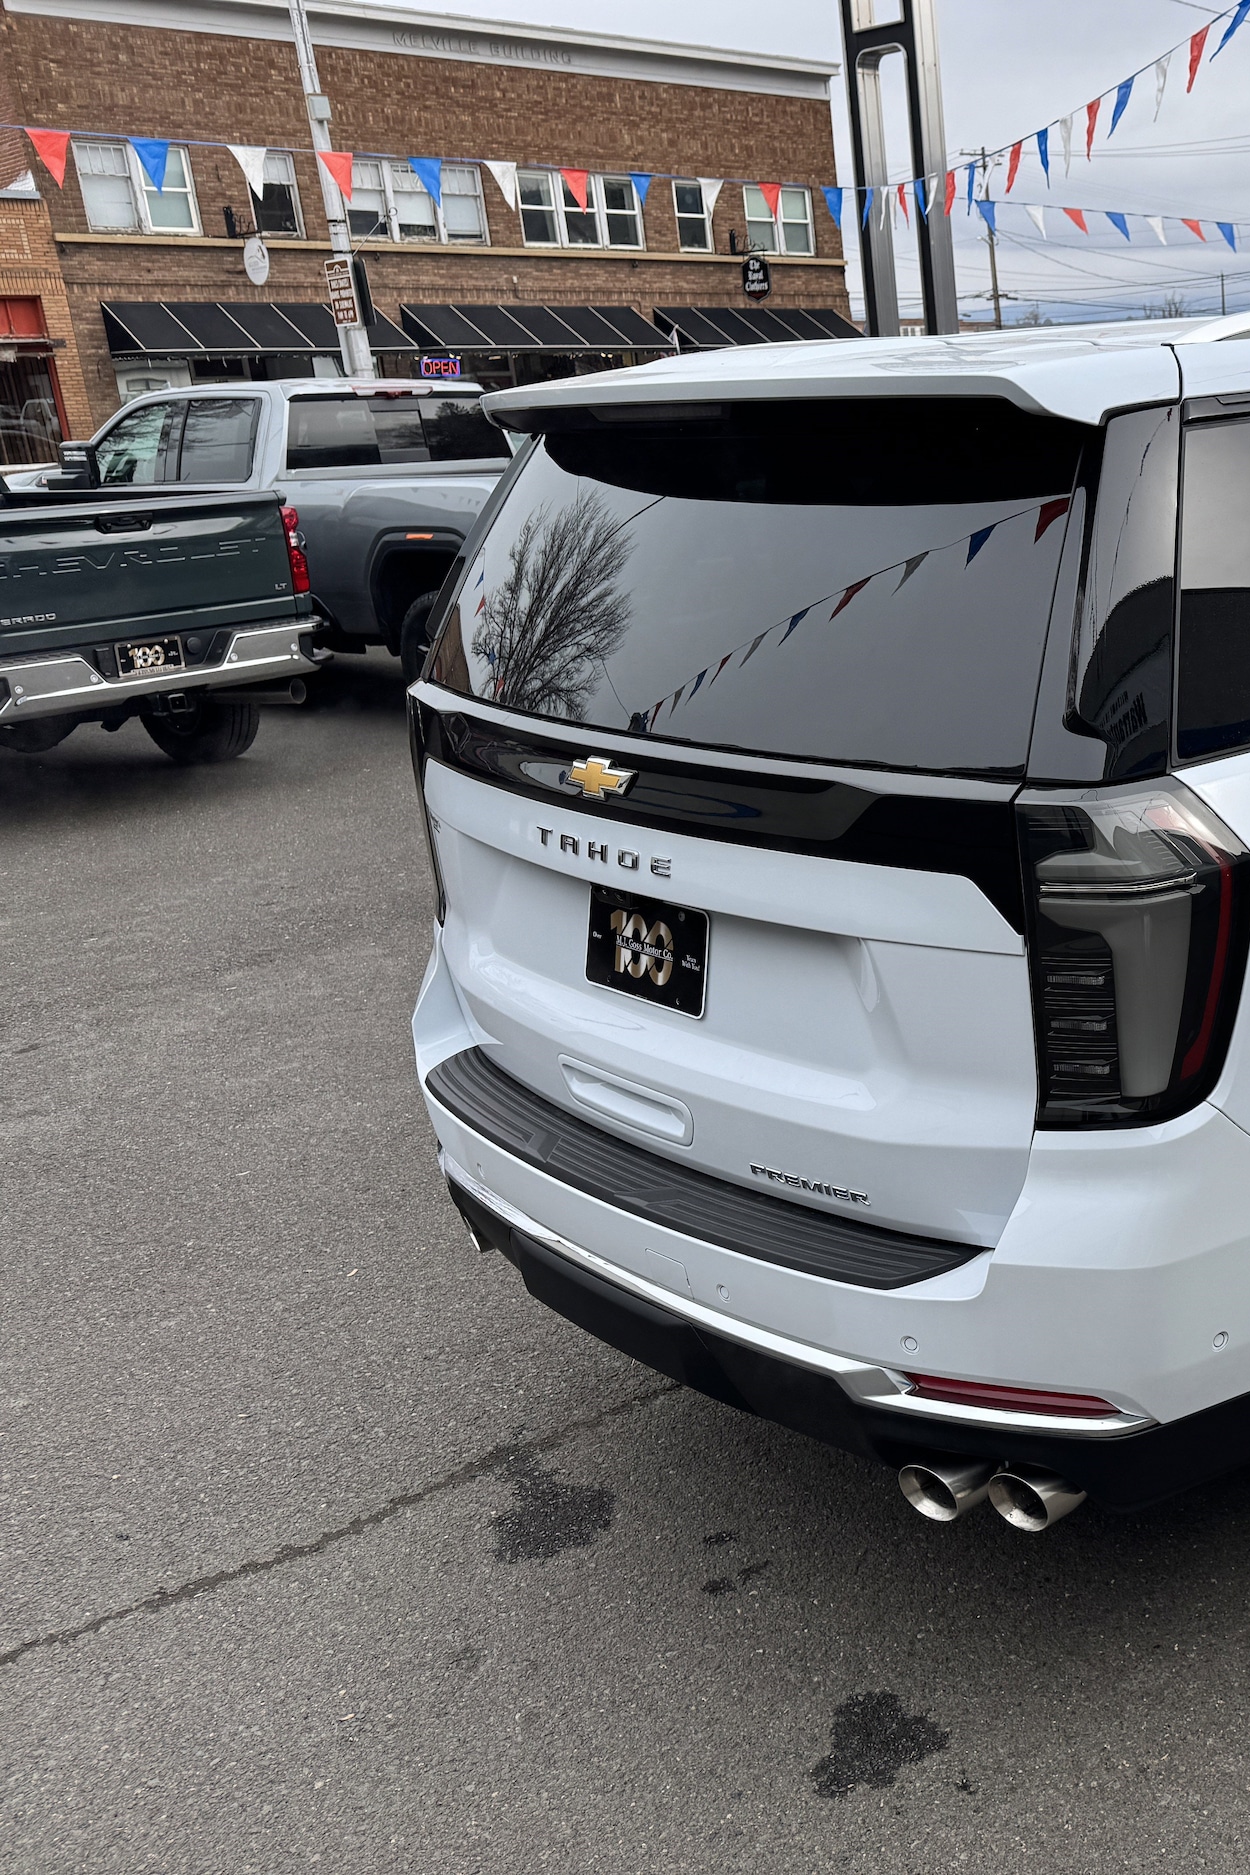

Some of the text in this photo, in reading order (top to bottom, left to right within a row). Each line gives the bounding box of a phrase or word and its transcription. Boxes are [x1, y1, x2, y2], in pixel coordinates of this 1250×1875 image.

[392, 31, 572, 65] MELVILLE BUILDING
[423, 360, 459, 376] OPEN
[0, 537, 267, 580] HEVROLET
[274, 582, 288, 591] LT
[128, 644, 165, 669] 100
[536, 823, 672, 878] TAHOE
[610, 909, 674, 986] 100
[628, 939, 643, 952] Goss
[643, 942, 662, 957] Motor
[662, 949, 674, 961] Co.
[749, 1162, 871, 1206] PREMIER
